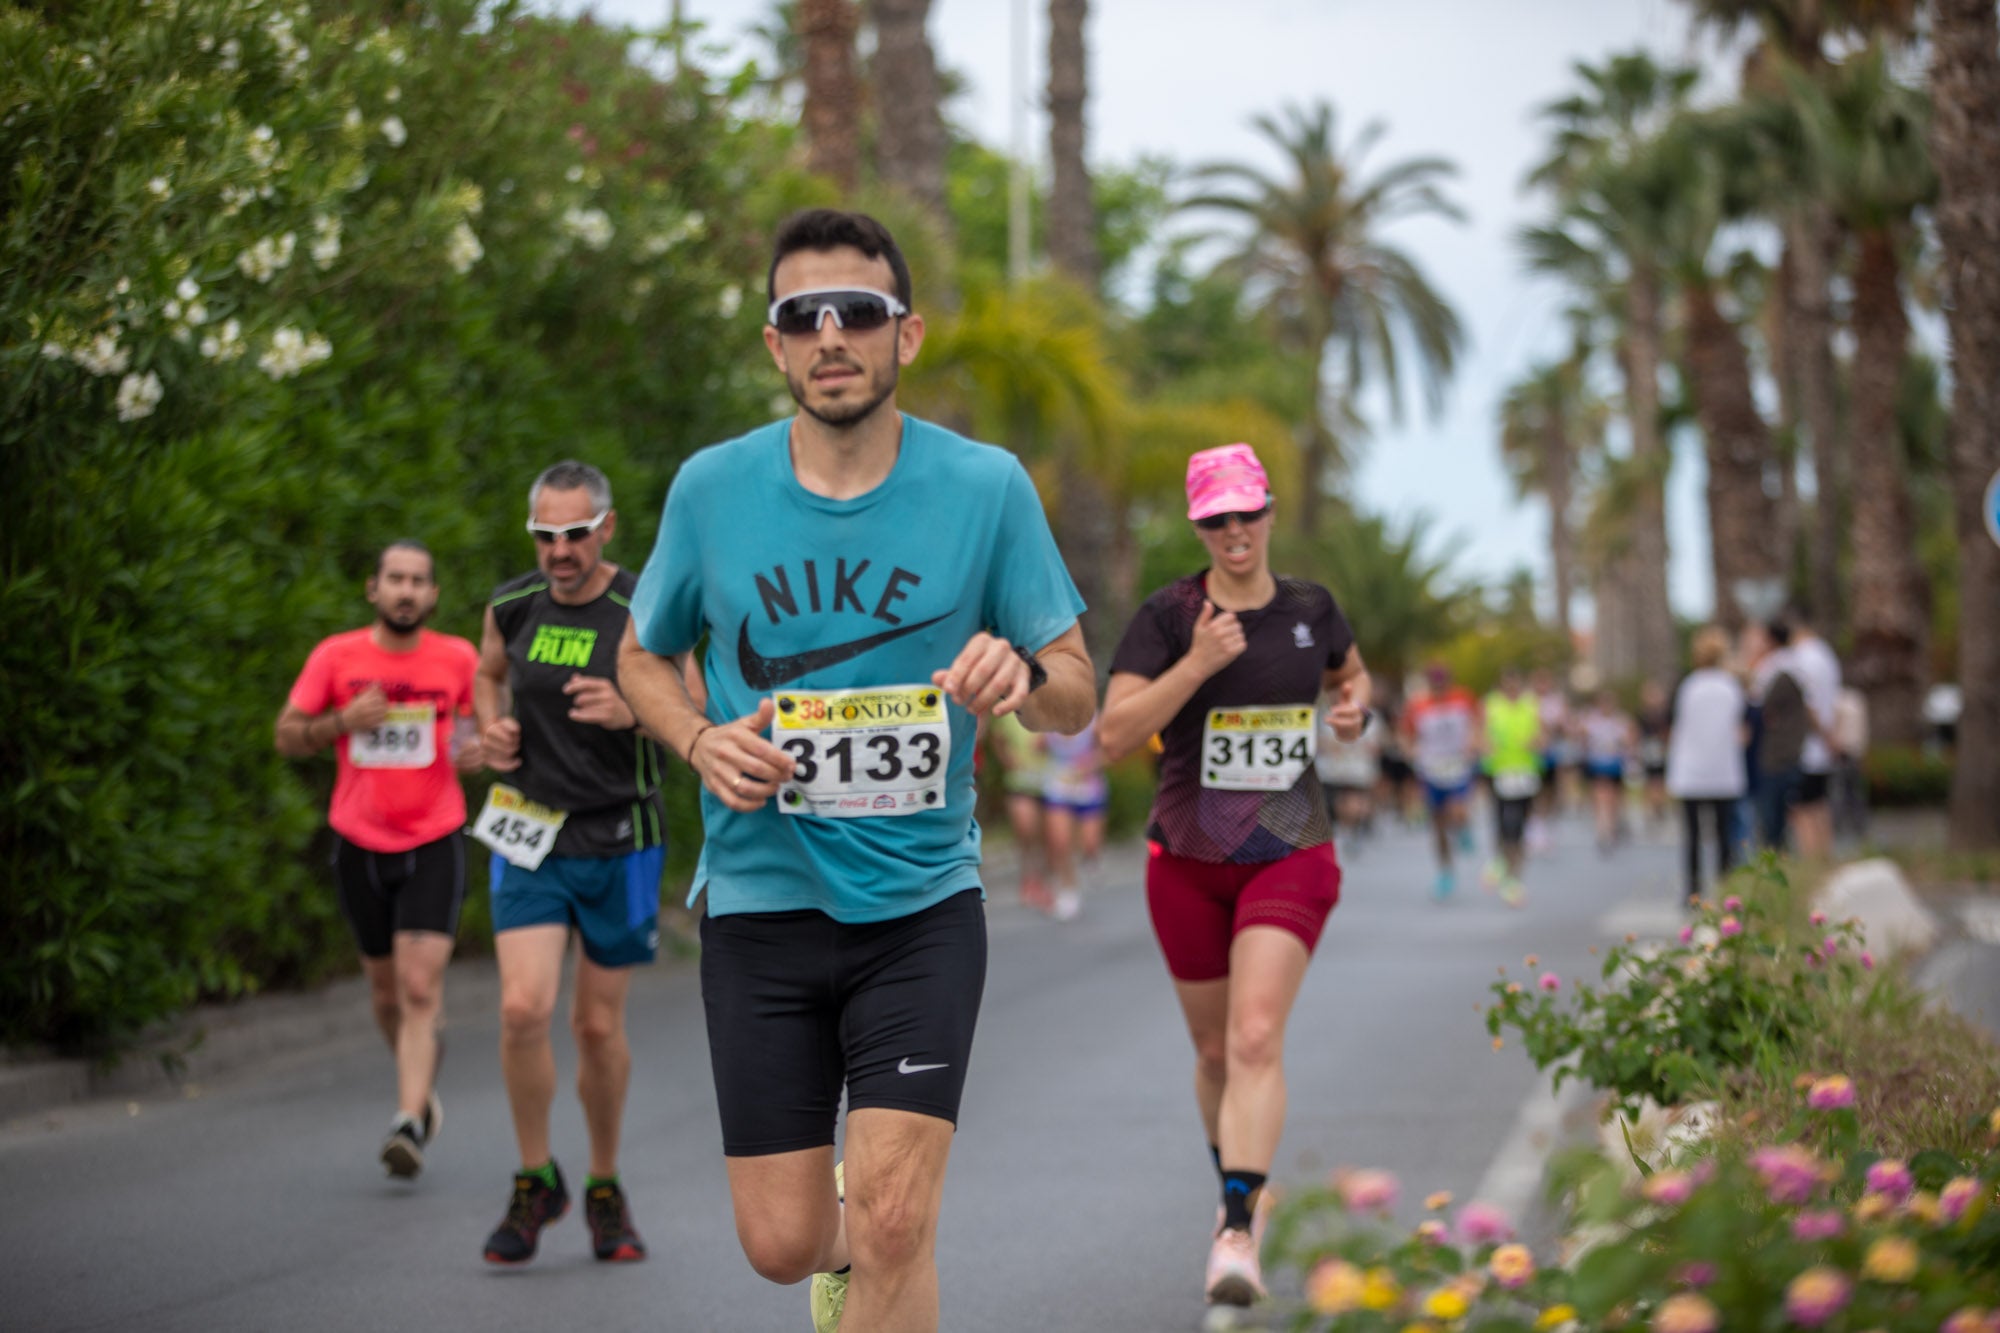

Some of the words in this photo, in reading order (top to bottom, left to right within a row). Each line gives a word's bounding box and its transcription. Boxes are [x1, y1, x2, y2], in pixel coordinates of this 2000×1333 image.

[754, 557, 922, 626] NIKE
[527, 637, 595, 668] RUN
[800, 699, 825, 720] 38
[827, 702, 912, 721] FONDO
[781, 732, 941, 784] 3133
[1210, 735, 1309, 768] 3134
[489, 815, 546, 851] 454
